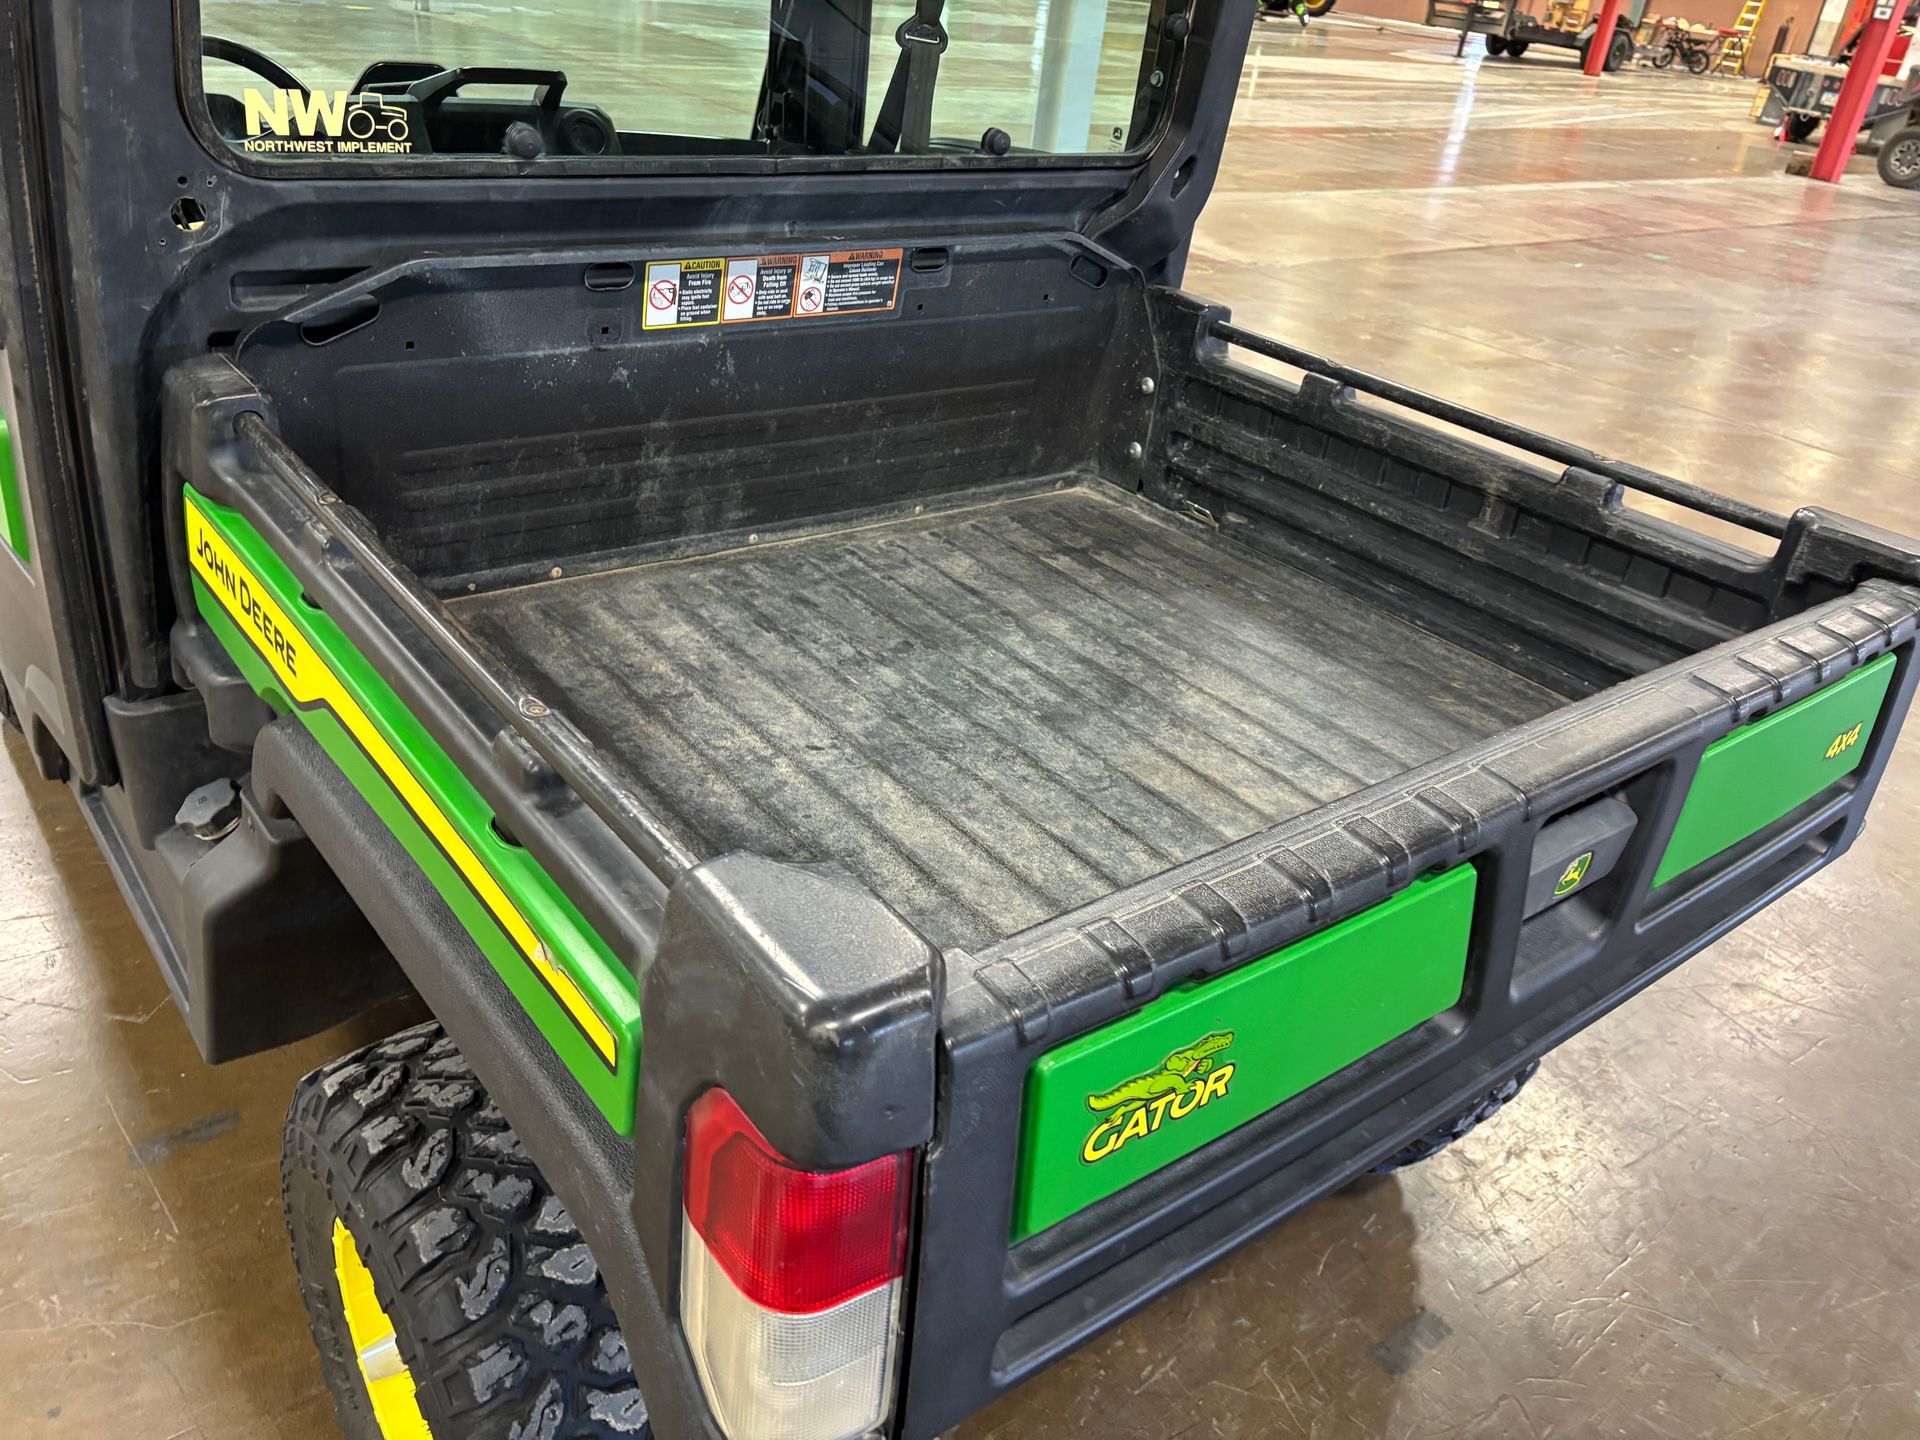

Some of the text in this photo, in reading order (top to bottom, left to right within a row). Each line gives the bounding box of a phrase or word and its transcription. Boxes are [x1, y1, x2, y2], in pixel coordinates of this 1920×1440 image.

[243, 88, 348, 137] NW
[244, 140, 412, 154] NORTHWEST IMPLEMENT
[768, 256, 797, 265] WARNING
[855, 251, 883, 260] WARNING
[692, 261, 720, 269] CAUTION
[197, 528, 298, 679] JOHN DEERE
[1082, 1063, 1237, 1163] GATOR
